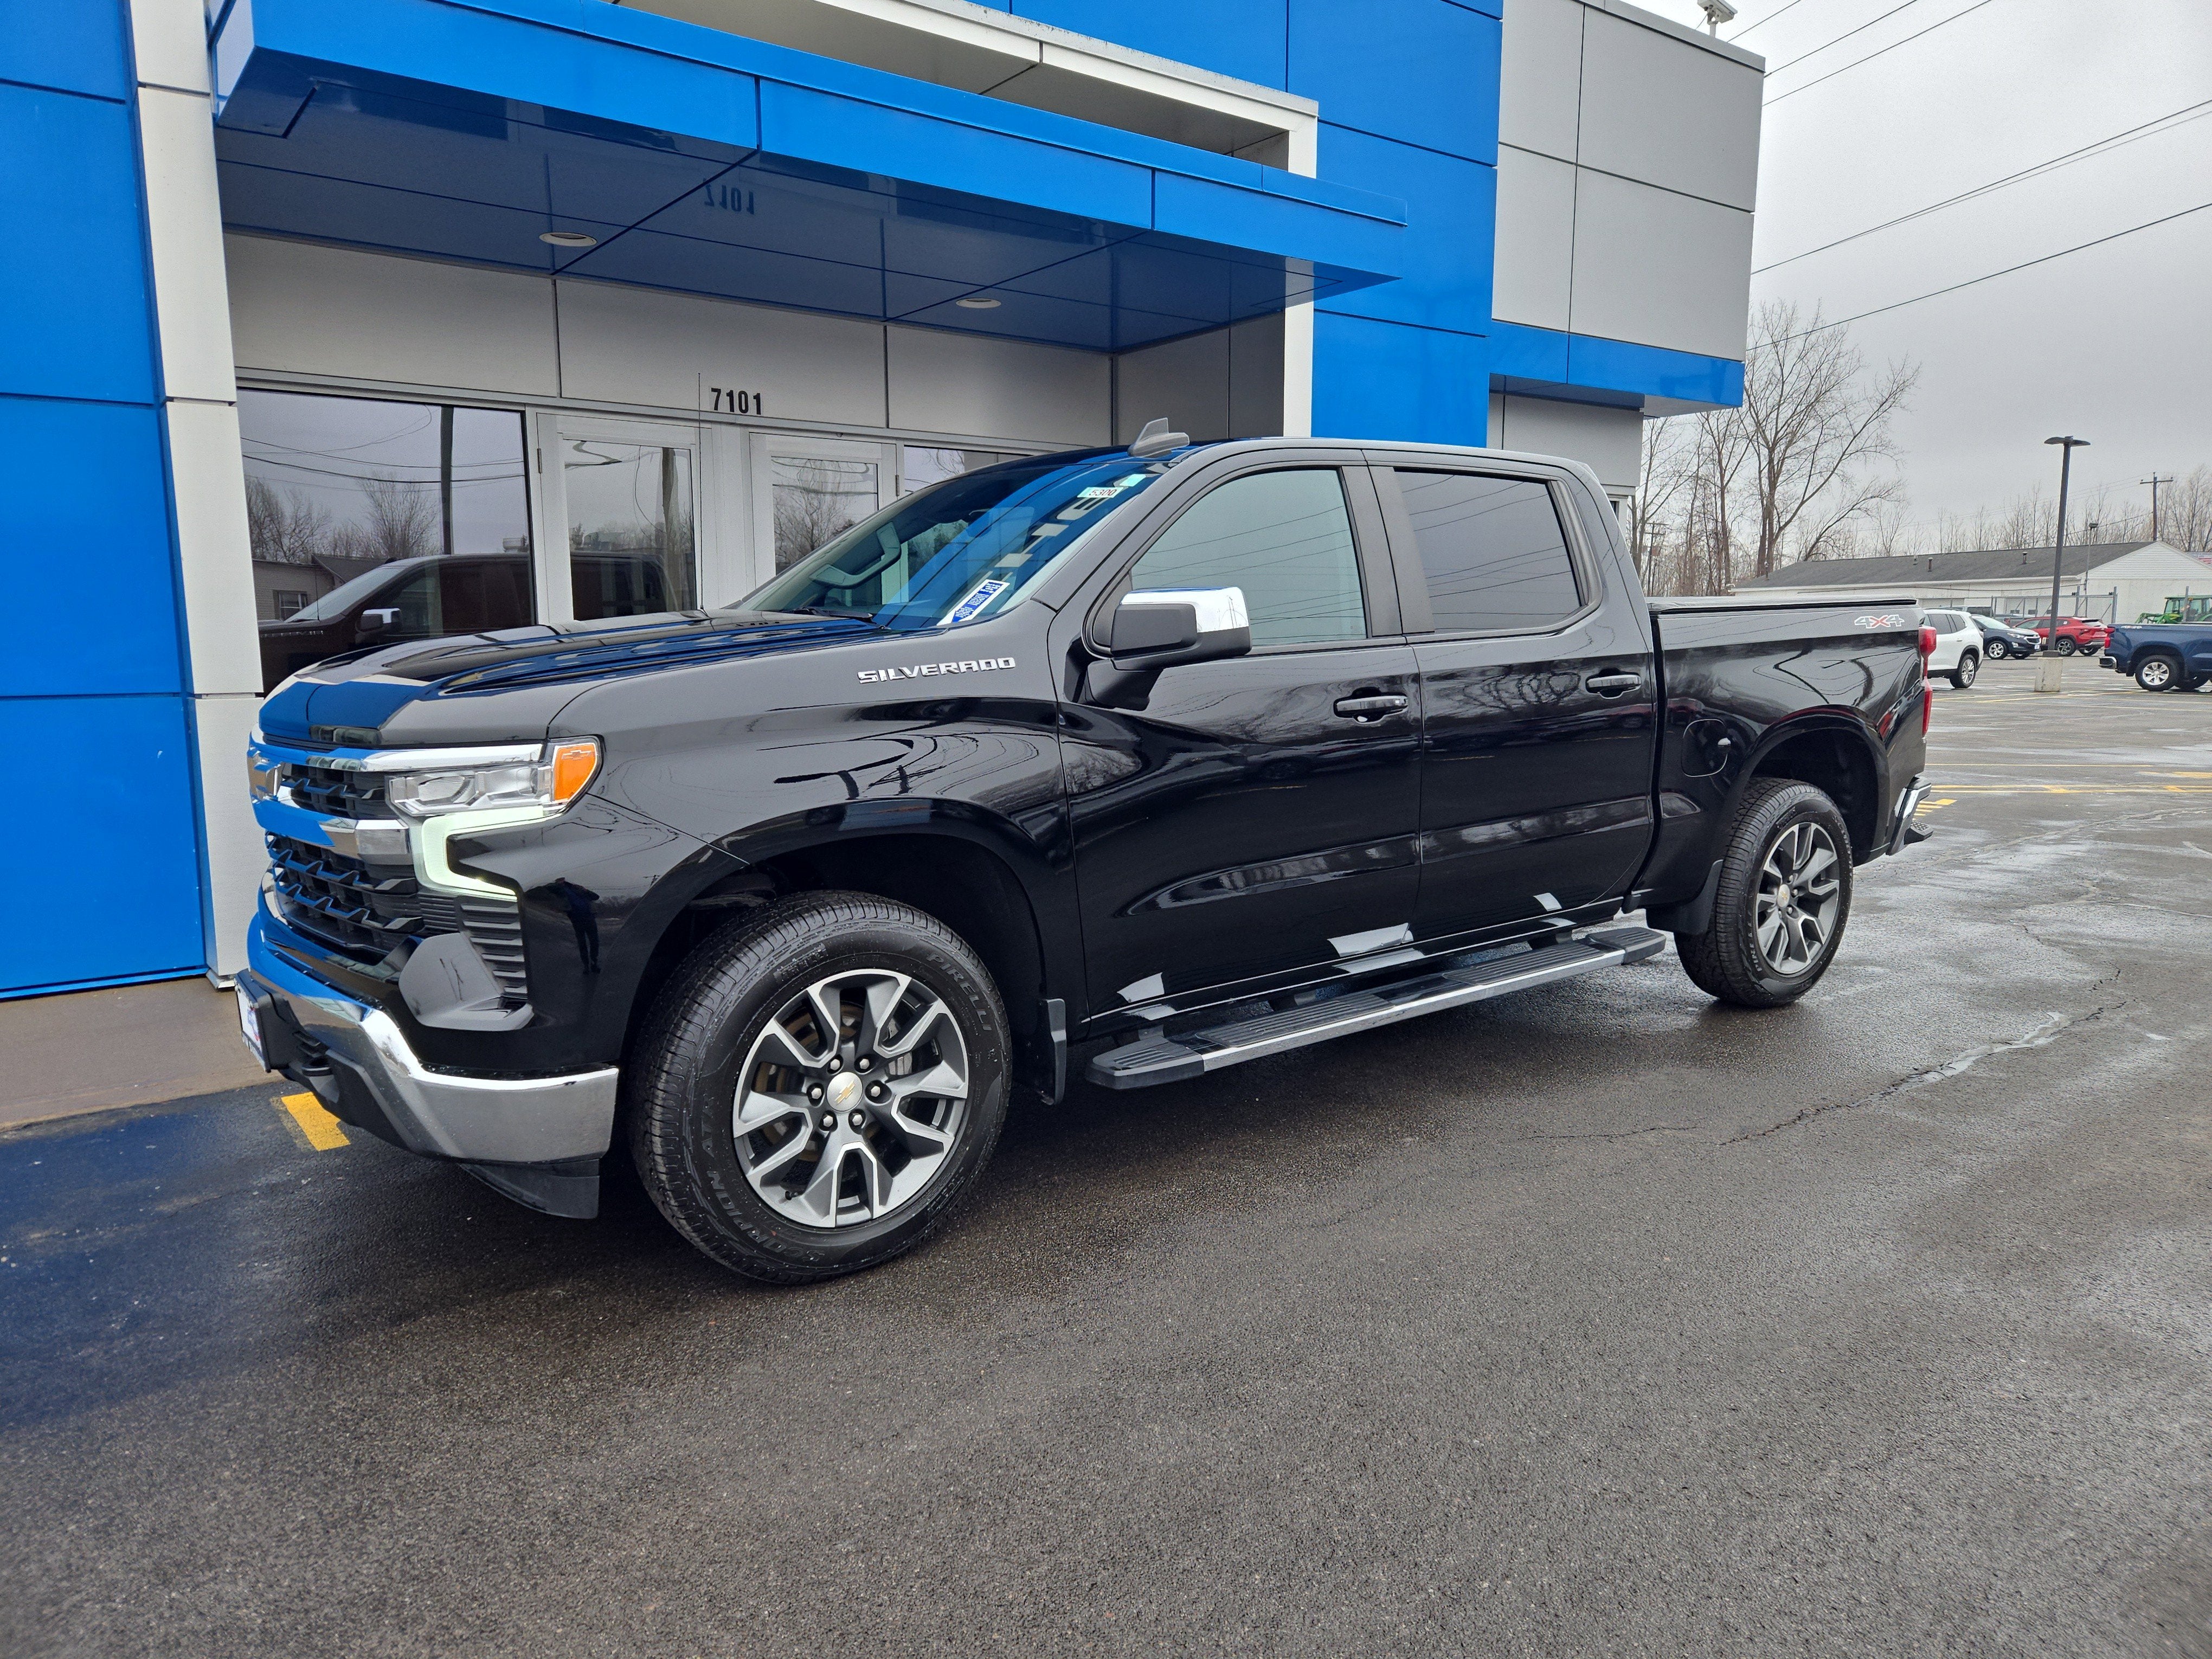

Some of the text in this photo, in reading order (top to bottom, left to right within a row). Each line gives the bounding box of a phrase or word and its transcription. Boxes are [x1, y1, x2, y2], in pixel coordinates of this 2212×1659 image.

[711, 388, 761, 415] 7101
[858, 657, 1015, 684] SILVERADO
[926, 954, 992, 1031] PIRELLI
